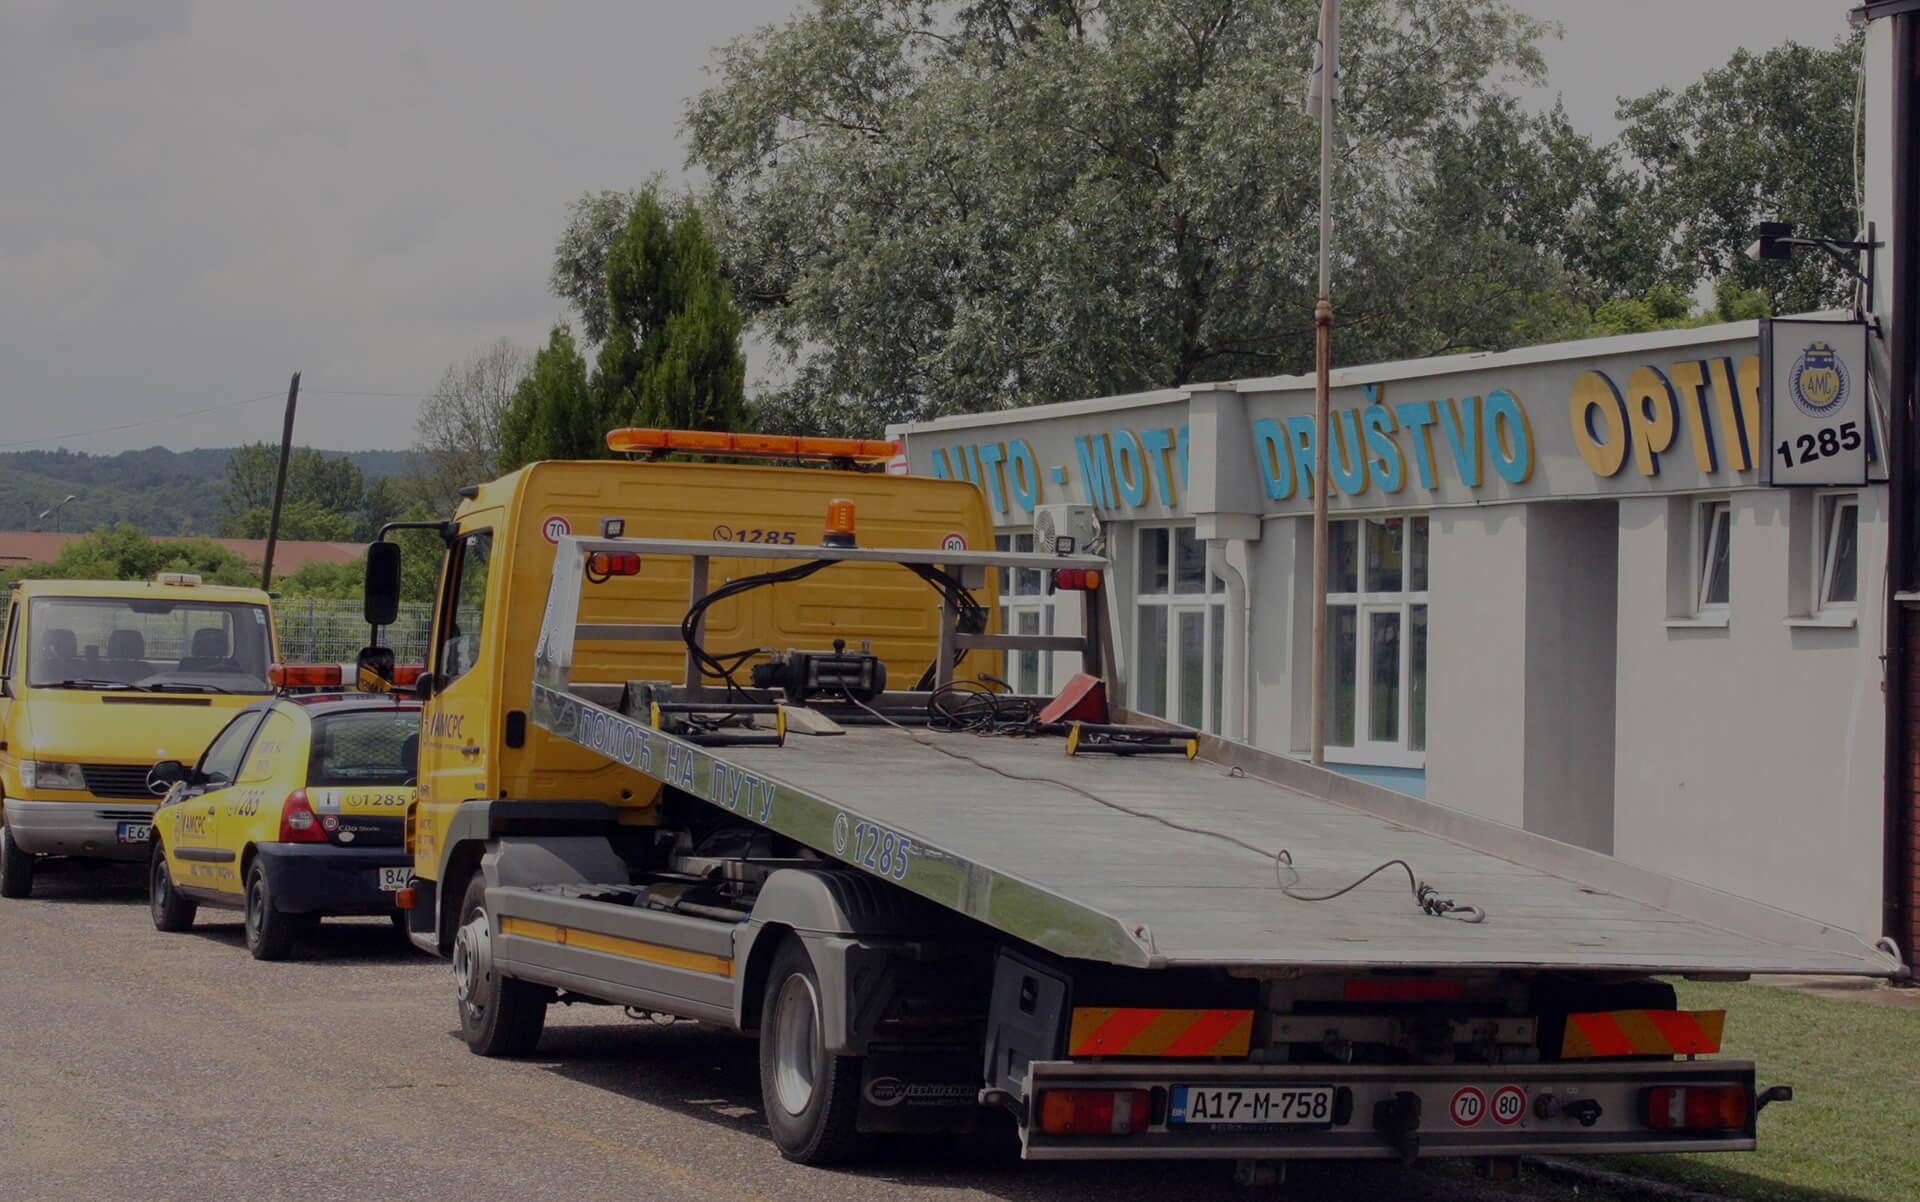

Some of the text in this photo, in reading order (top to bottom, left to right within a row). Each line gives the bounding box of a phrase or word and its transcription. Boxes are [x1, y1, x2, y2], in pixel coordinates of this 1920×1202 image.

[1253, 384, 1535, 500] DRUŠTVO
[1777, 421, 1861, 469] 1285
[549, 523, 565, 538] 70
[735, 529, 798, 545] 1285
[947, 539, 961, 550] 80
[364, 794, 406, 806] 1285
[578, 706, 913, 880] ПОМОЋ НА ПУТУ 1285
[1191, 1091, 1328, 1119] A17-M-758
[1459, 1097, 1479, 1117] 70
[1498, 1095, 1519, 1114] 80
